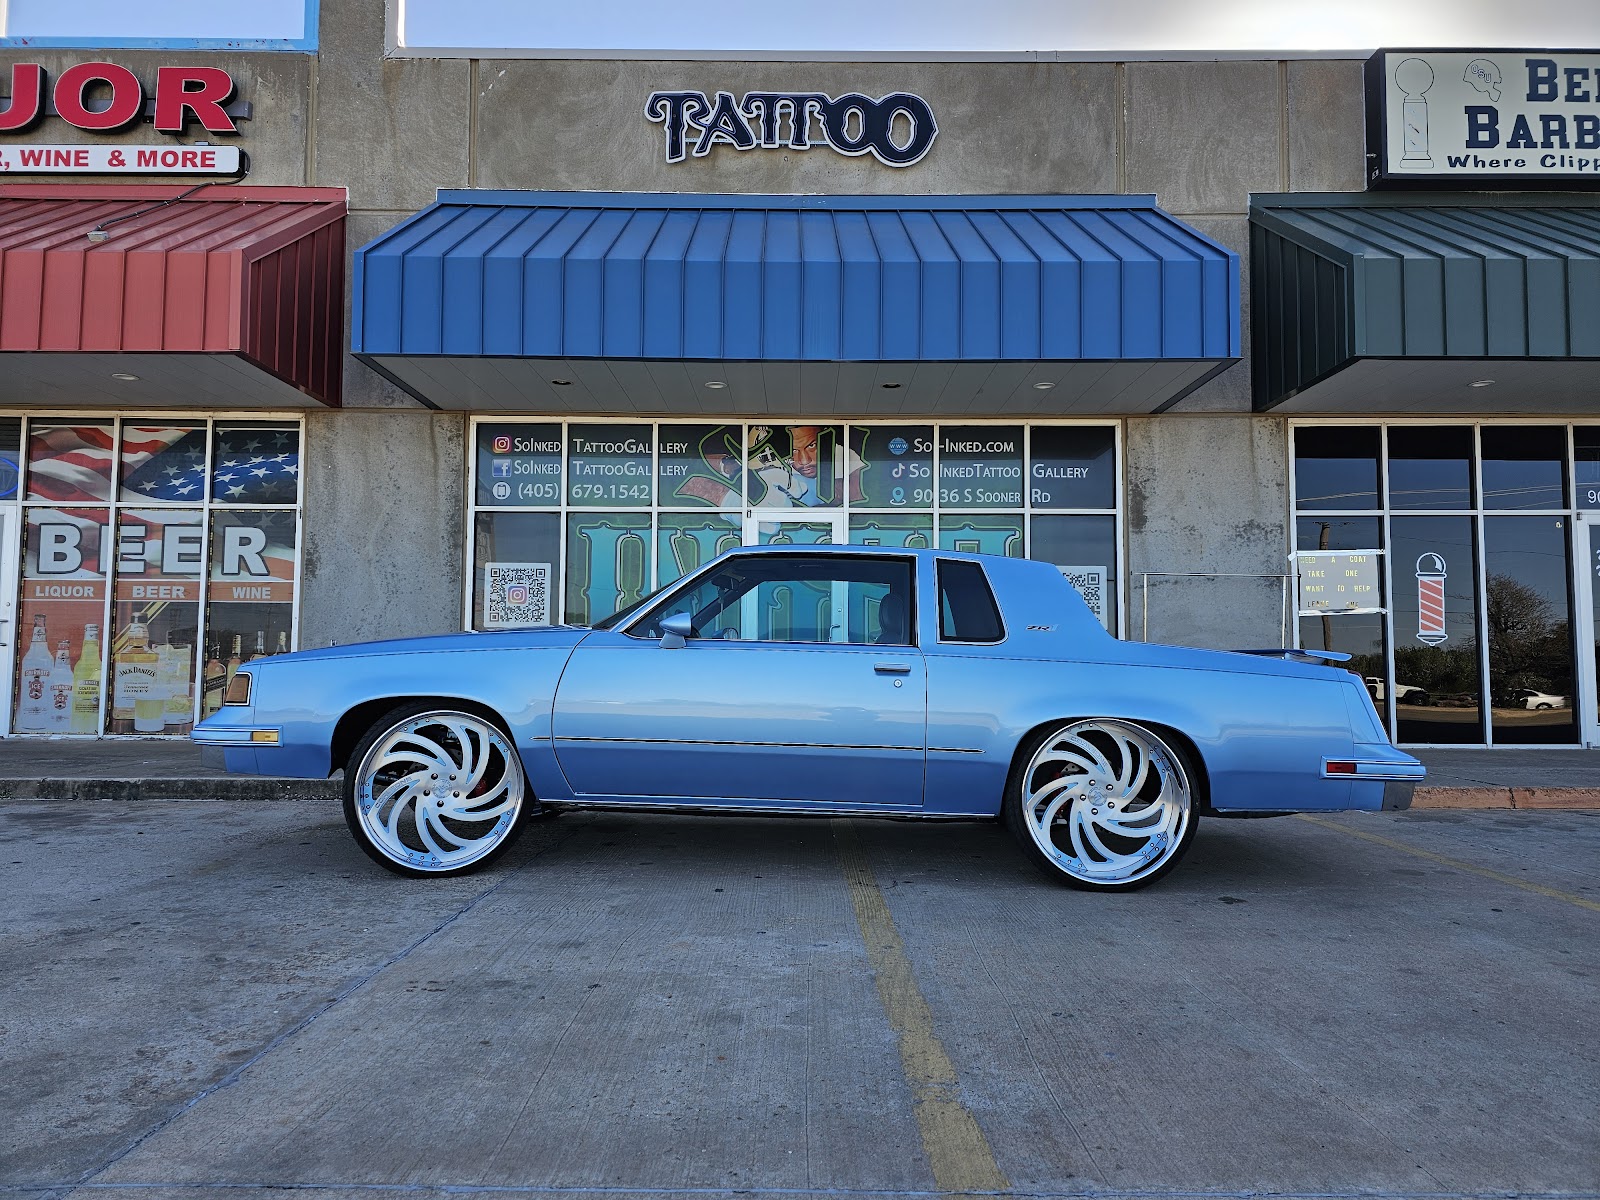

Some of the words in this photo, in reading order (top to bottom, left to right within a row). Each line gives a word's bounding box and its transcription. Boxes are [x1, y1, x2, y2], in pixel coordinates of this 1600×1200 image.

[1471, 64, 1492, 83] OSU
[1525, 59, 1600, 102] BE
[644, 90, 940, 168] TATTOO
[1464, 105, 1600, 149] BARB
[20, 149, 89, 167] WINE
[108, 149, 126, 167] &
[137, 150, 216, 168] MORE
[1447, 154, 1527, 168] Where
[518, 483, 559, 499] (405)
[571, 484, 649, 499] 679.1542
[964, 489, 972, 502] S
[37, 522, 270, 576] BEER
[1345, 569, 1358, 577] ONE
[35, 585, 94, 598] LIQUOR
[132, 585, 185, 599] BEER
[232, 586, 271, 600] WINE
[1305, 585, 1324, 593] WANT
[1353, 585, 1371, 593] HELP
